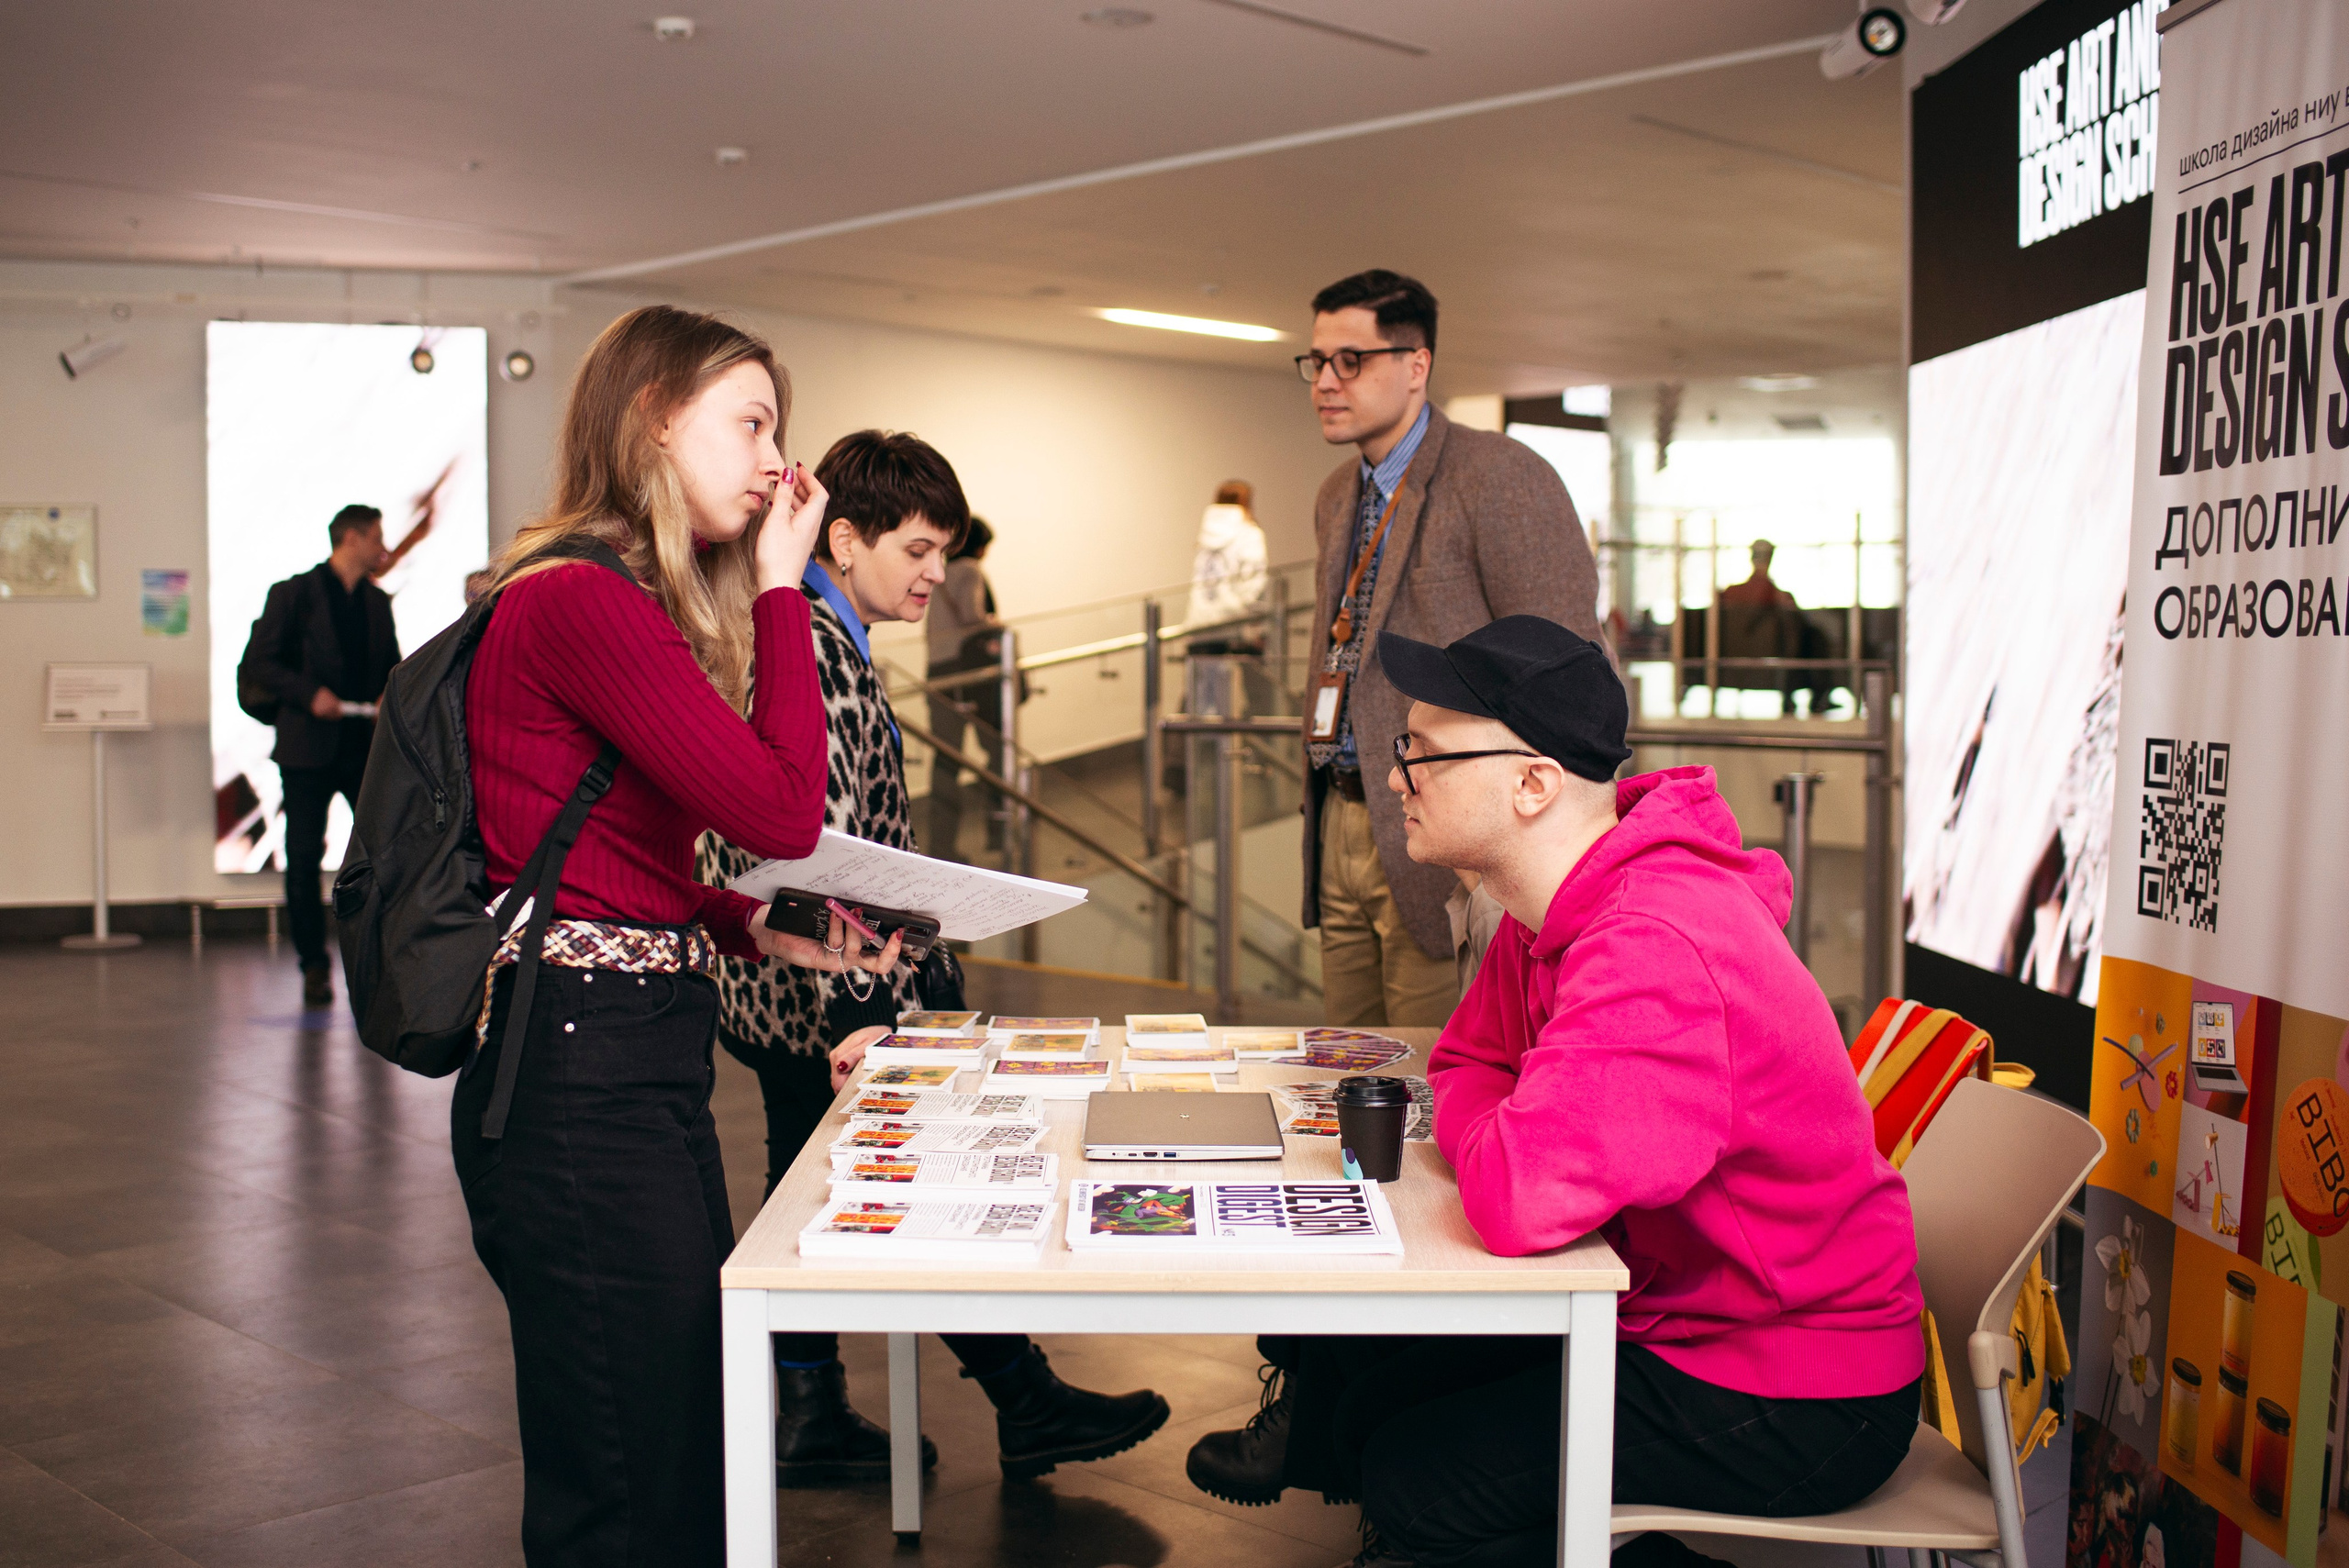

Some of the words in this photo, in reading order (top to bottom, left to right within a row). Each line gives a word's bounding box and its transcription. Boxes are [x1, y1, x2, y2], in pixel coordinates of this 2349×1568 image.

[2020, 48, 2065, 159] HSE
[2065, 17, 2115, 135] ART
[2179, 139, 2228, 177] школа
[2231, 108, 2299, 161] дизайна
[2304, 90, 2341, 124] ниу
[2019, 120, 2103, 249] DESIGN
[2168, 185, 2254, 342] HSE
[2257, 148, 2349, 318] ART
[2159, 307, 2323, 475] DESIGN
[2154, 576, 2349, 639] ОБРАЗОВА
[1216, 1185, 1286, 1228] DIGEST
[1283, 1184, 1375, 1236] DESIGN
